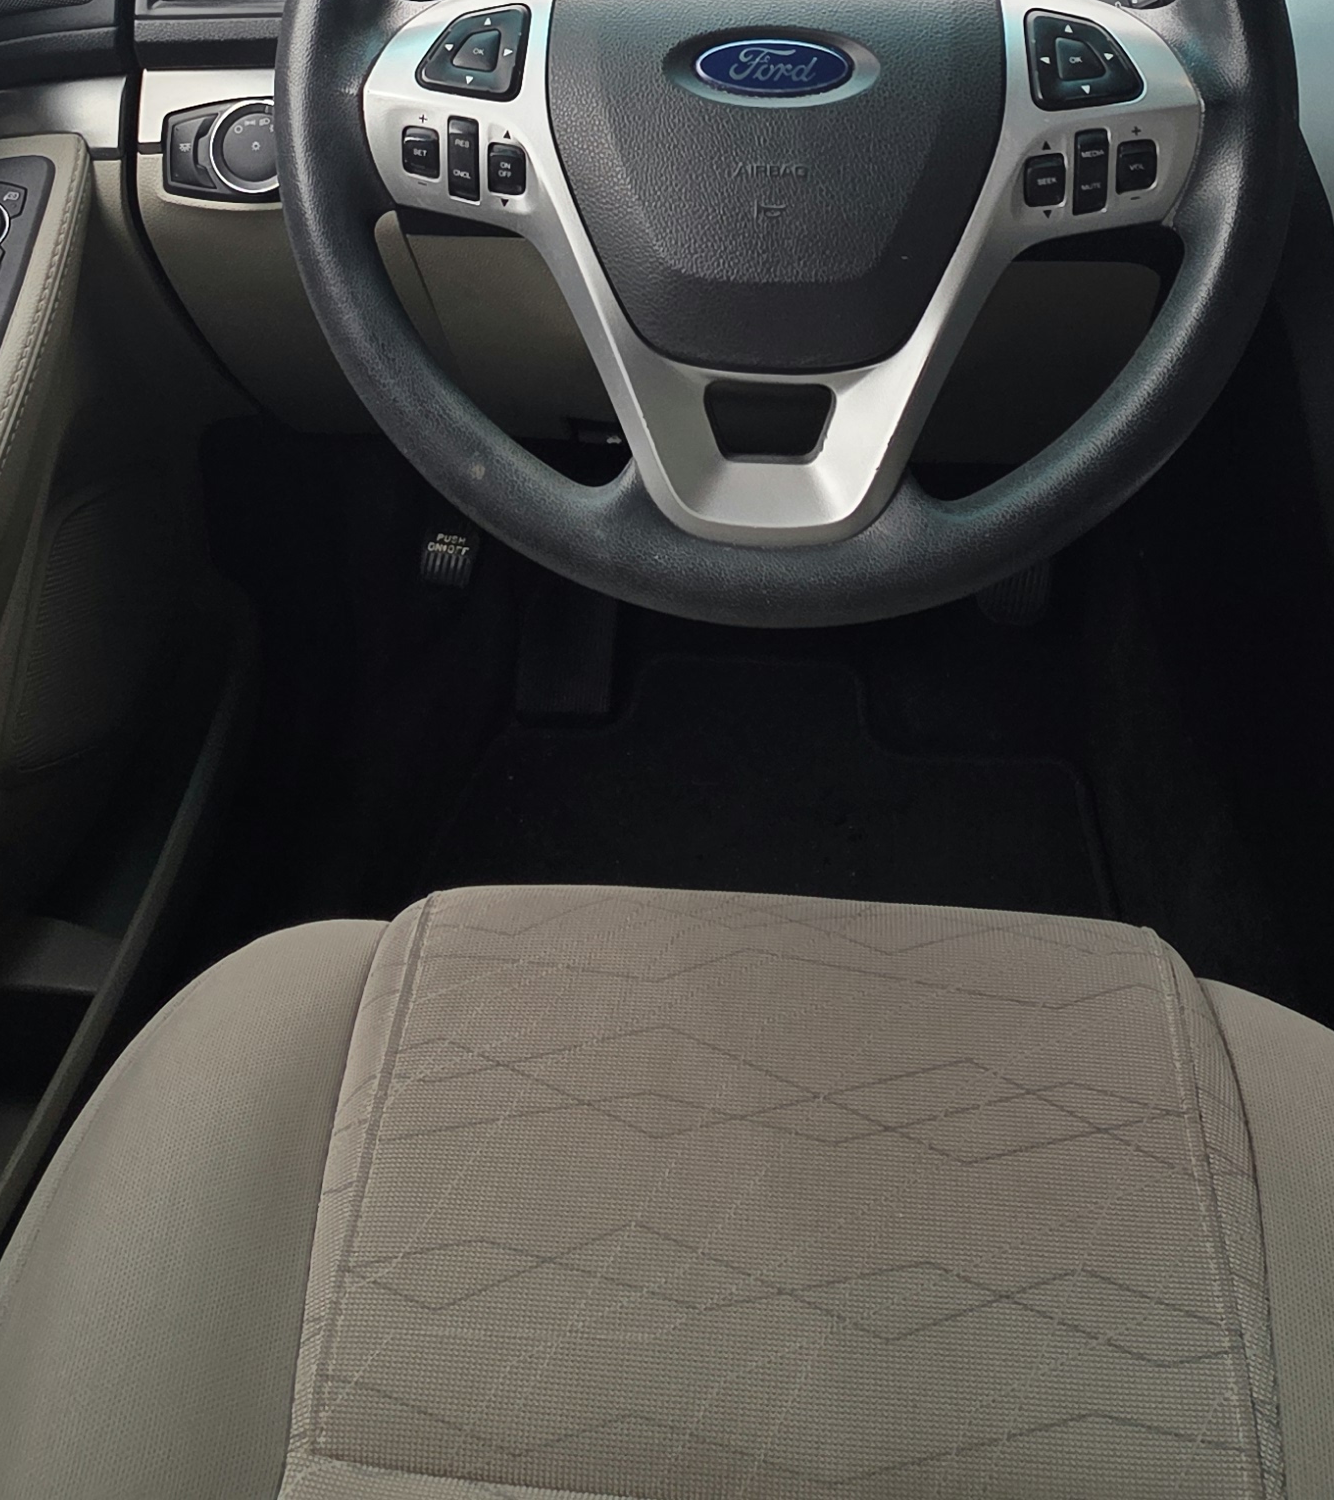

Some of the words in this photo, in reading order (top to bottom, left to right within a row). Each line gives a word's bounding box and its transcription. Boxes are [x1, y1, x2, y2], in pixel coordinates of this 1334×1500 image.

[472, 47, 485, 56] OK
[729, 46, 818, 82] Ford
[1068, 55, 1083, 64] OK
[454, 139, 470, 149] RES
[413, 148, 428, 157] SET
[1080, 148, 1105, 158] MEDIA
[499, 161, 511, 169] ON
[1128, 163, 1145, 171] VOL
[452, 169, 471, 180] CNCL
[497, 170, 512, 178] OFF
[732, 161, 810, 179] AIRBAG
[1037, 177, 1057, 186] SEEK
[1080, 182, 1102, 191] MUTE
[436, 533, 467, 545] PUSH
